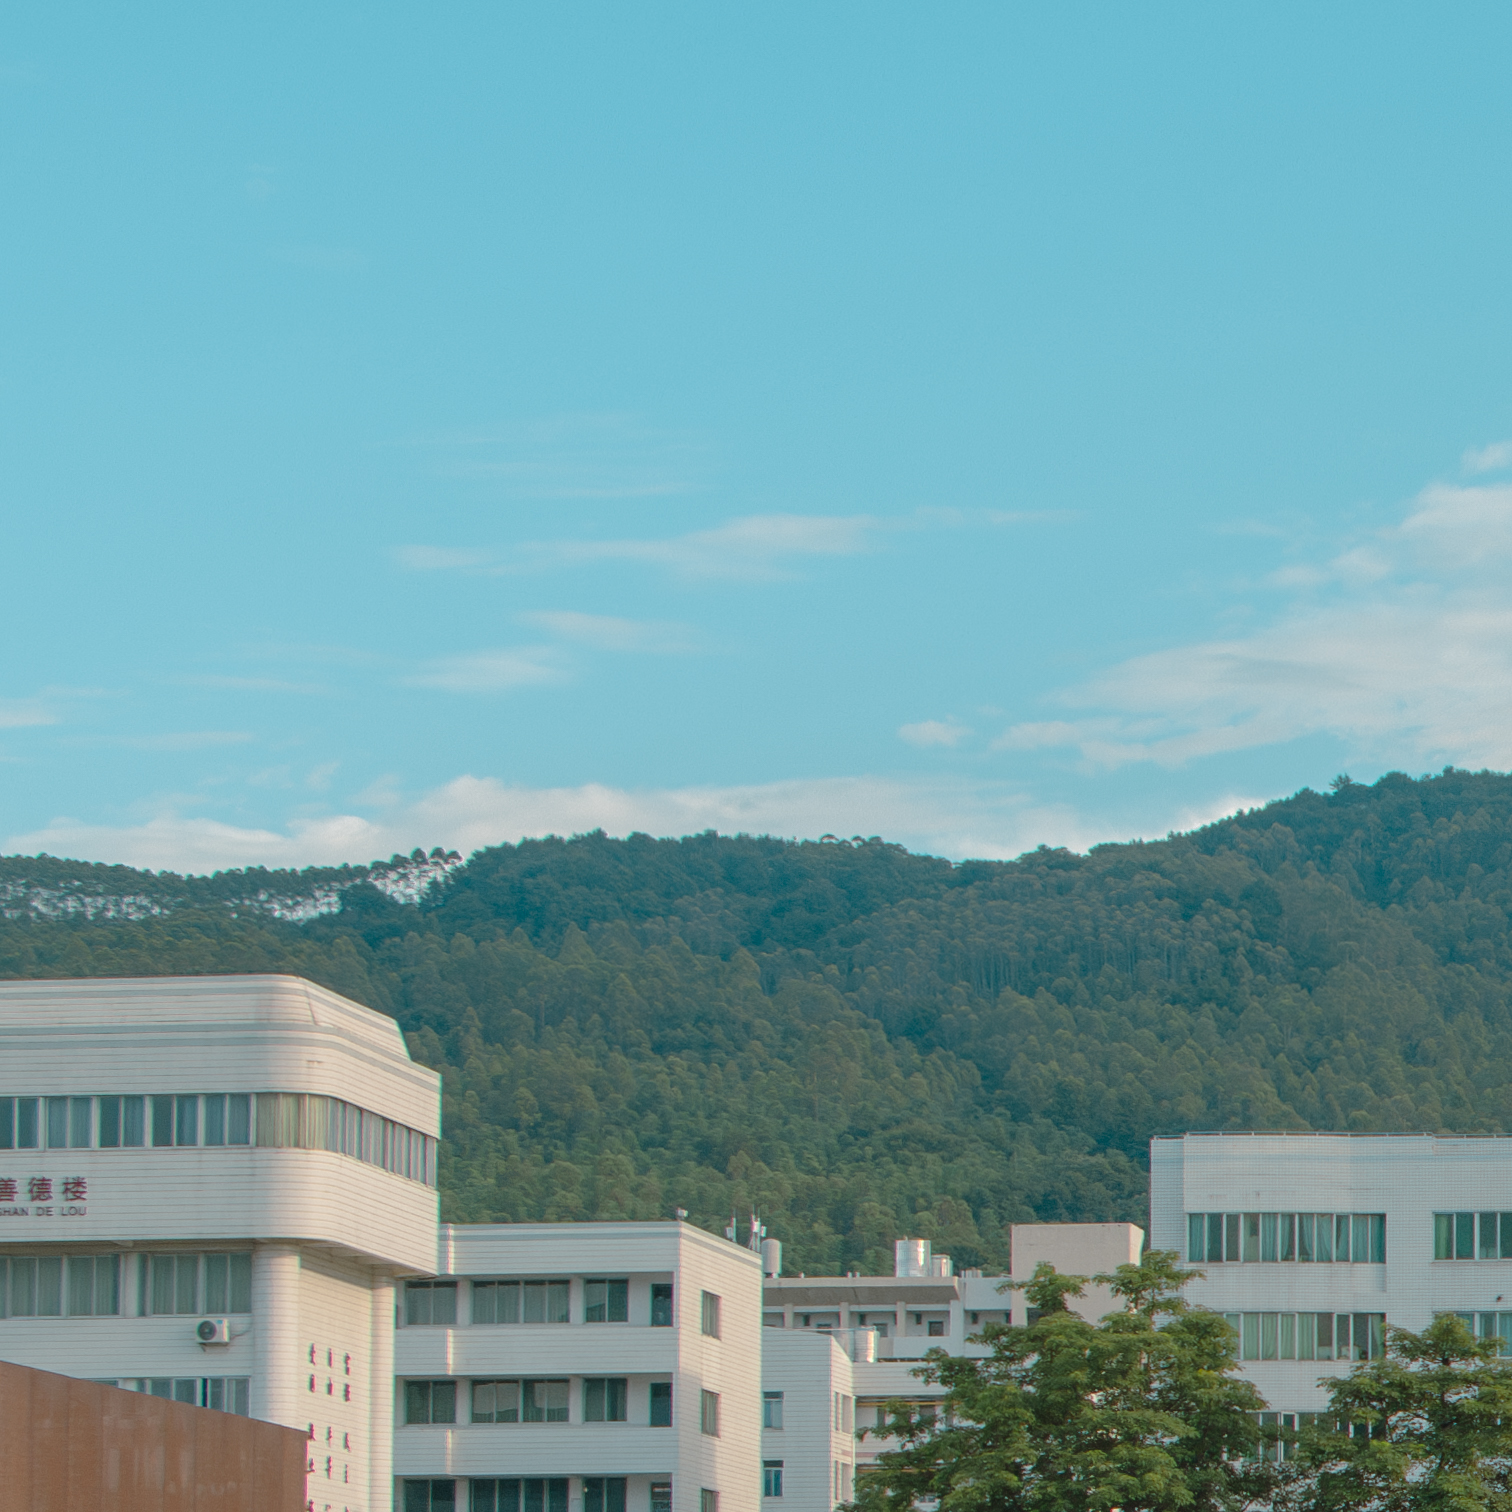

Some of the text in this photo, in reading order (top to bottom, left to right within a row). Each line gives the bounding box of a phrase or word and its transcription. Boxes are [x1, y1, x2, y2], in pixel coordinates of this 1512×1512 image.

[0, 1176, 88, 1201] 善德楼
[36, 1206, 54, 1216] DE
[61, 1206, 87, 1216] LOU
